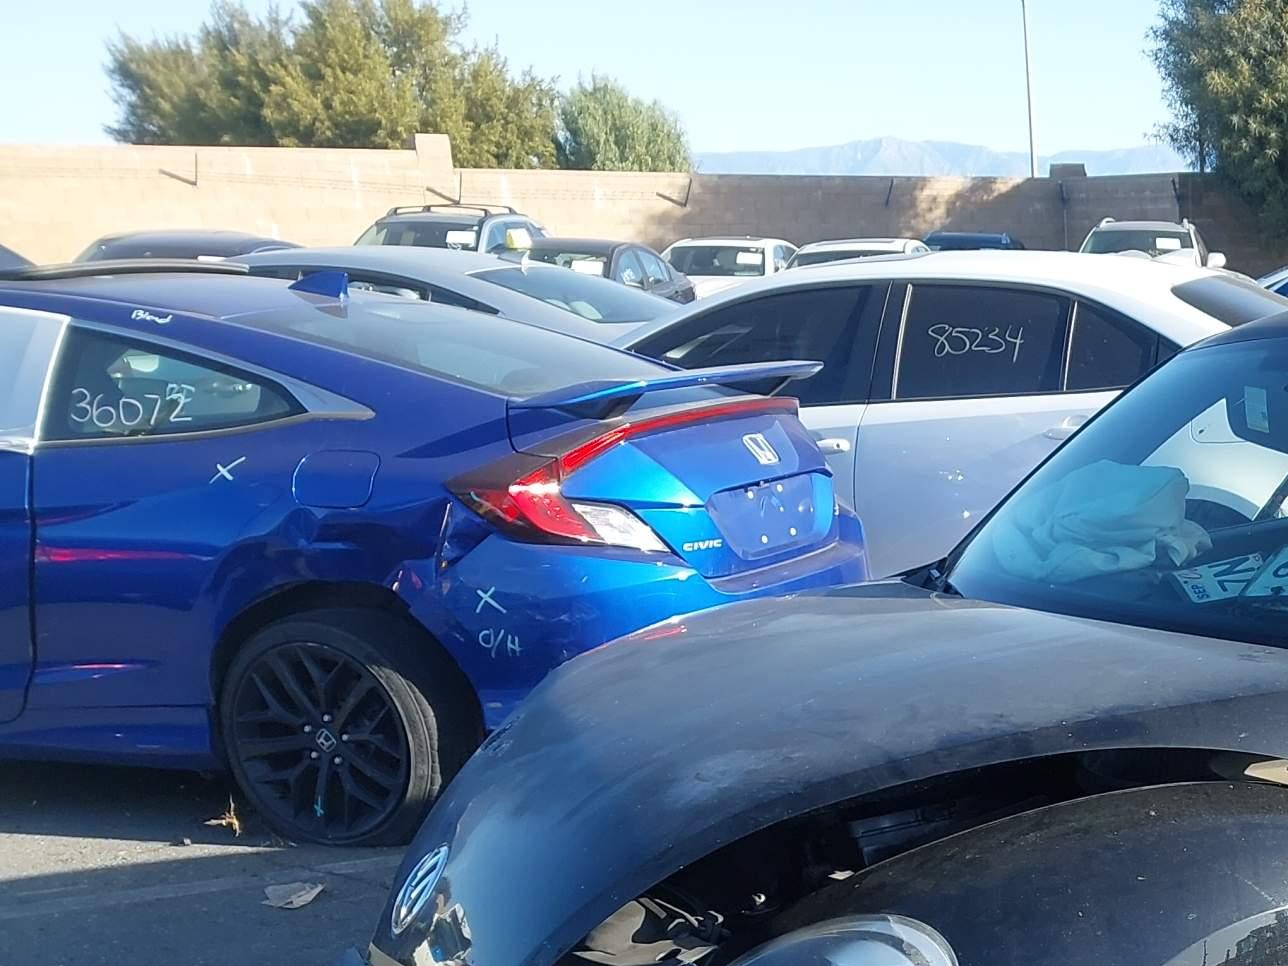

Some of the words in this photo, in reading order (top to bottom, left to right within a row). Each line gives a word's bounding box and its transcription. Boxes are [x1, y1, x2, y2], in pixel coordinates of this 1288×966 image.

[928, 324, 1024, 362] 85234
[71, 388, 193, 427] 36072
[682, 538, 722, 553] CIVIC
